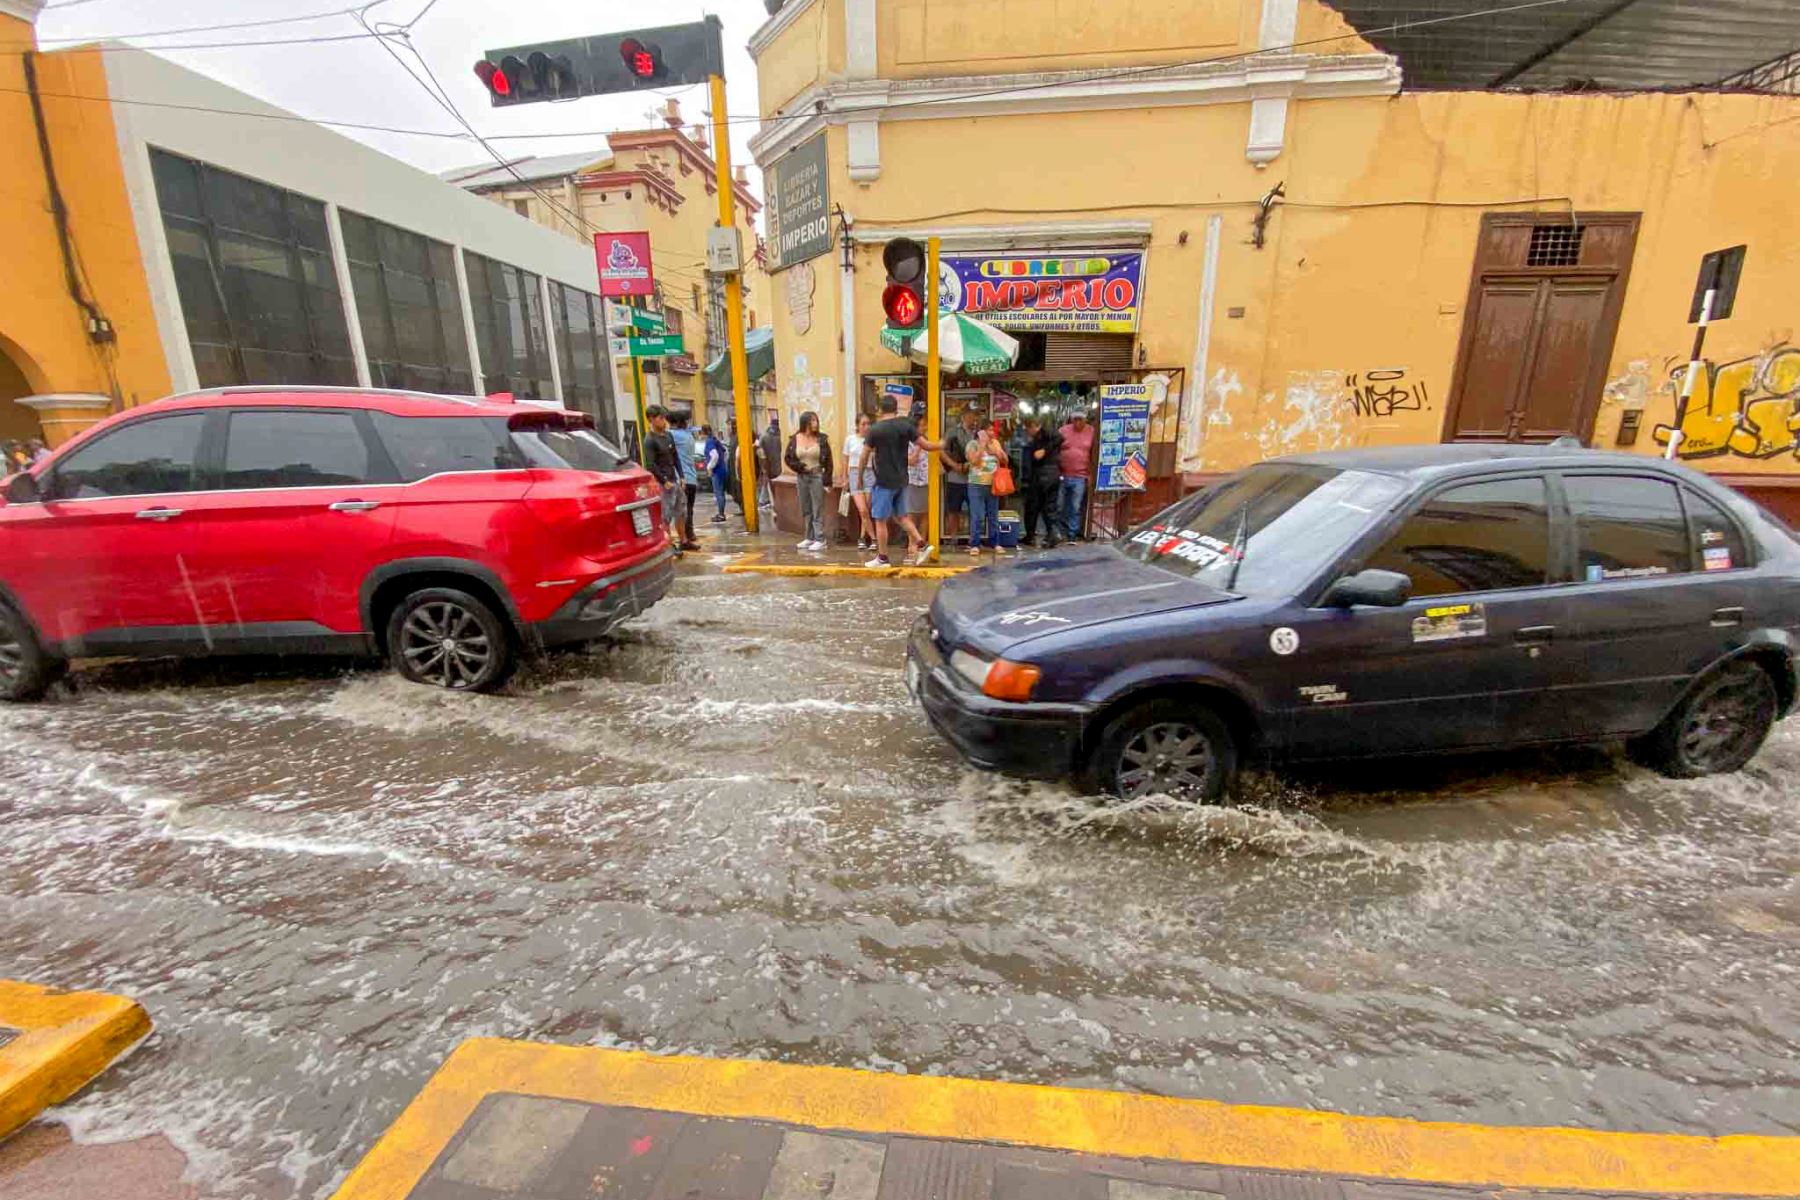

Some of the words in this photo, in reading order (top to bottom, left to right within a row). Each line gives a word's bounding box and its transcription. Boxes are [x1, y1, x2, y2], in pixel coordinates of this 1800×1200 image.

[783, 195, 823, 225] DEPORTES
[782, 216, 828, 251] IMPERIO
[964, 278, 1134, 313] IMPERIO
[1009, 312, 1048, 320] ESCOLARES
[1049, 312, 1057, 320] AL
[1059, 312, 1073, 320] POR
[1075, 312, 1099, 320] MAYOR
[1107, 312, 1132, 320] MENOR
[1107, 386, 1146, 396] IMPERIO
